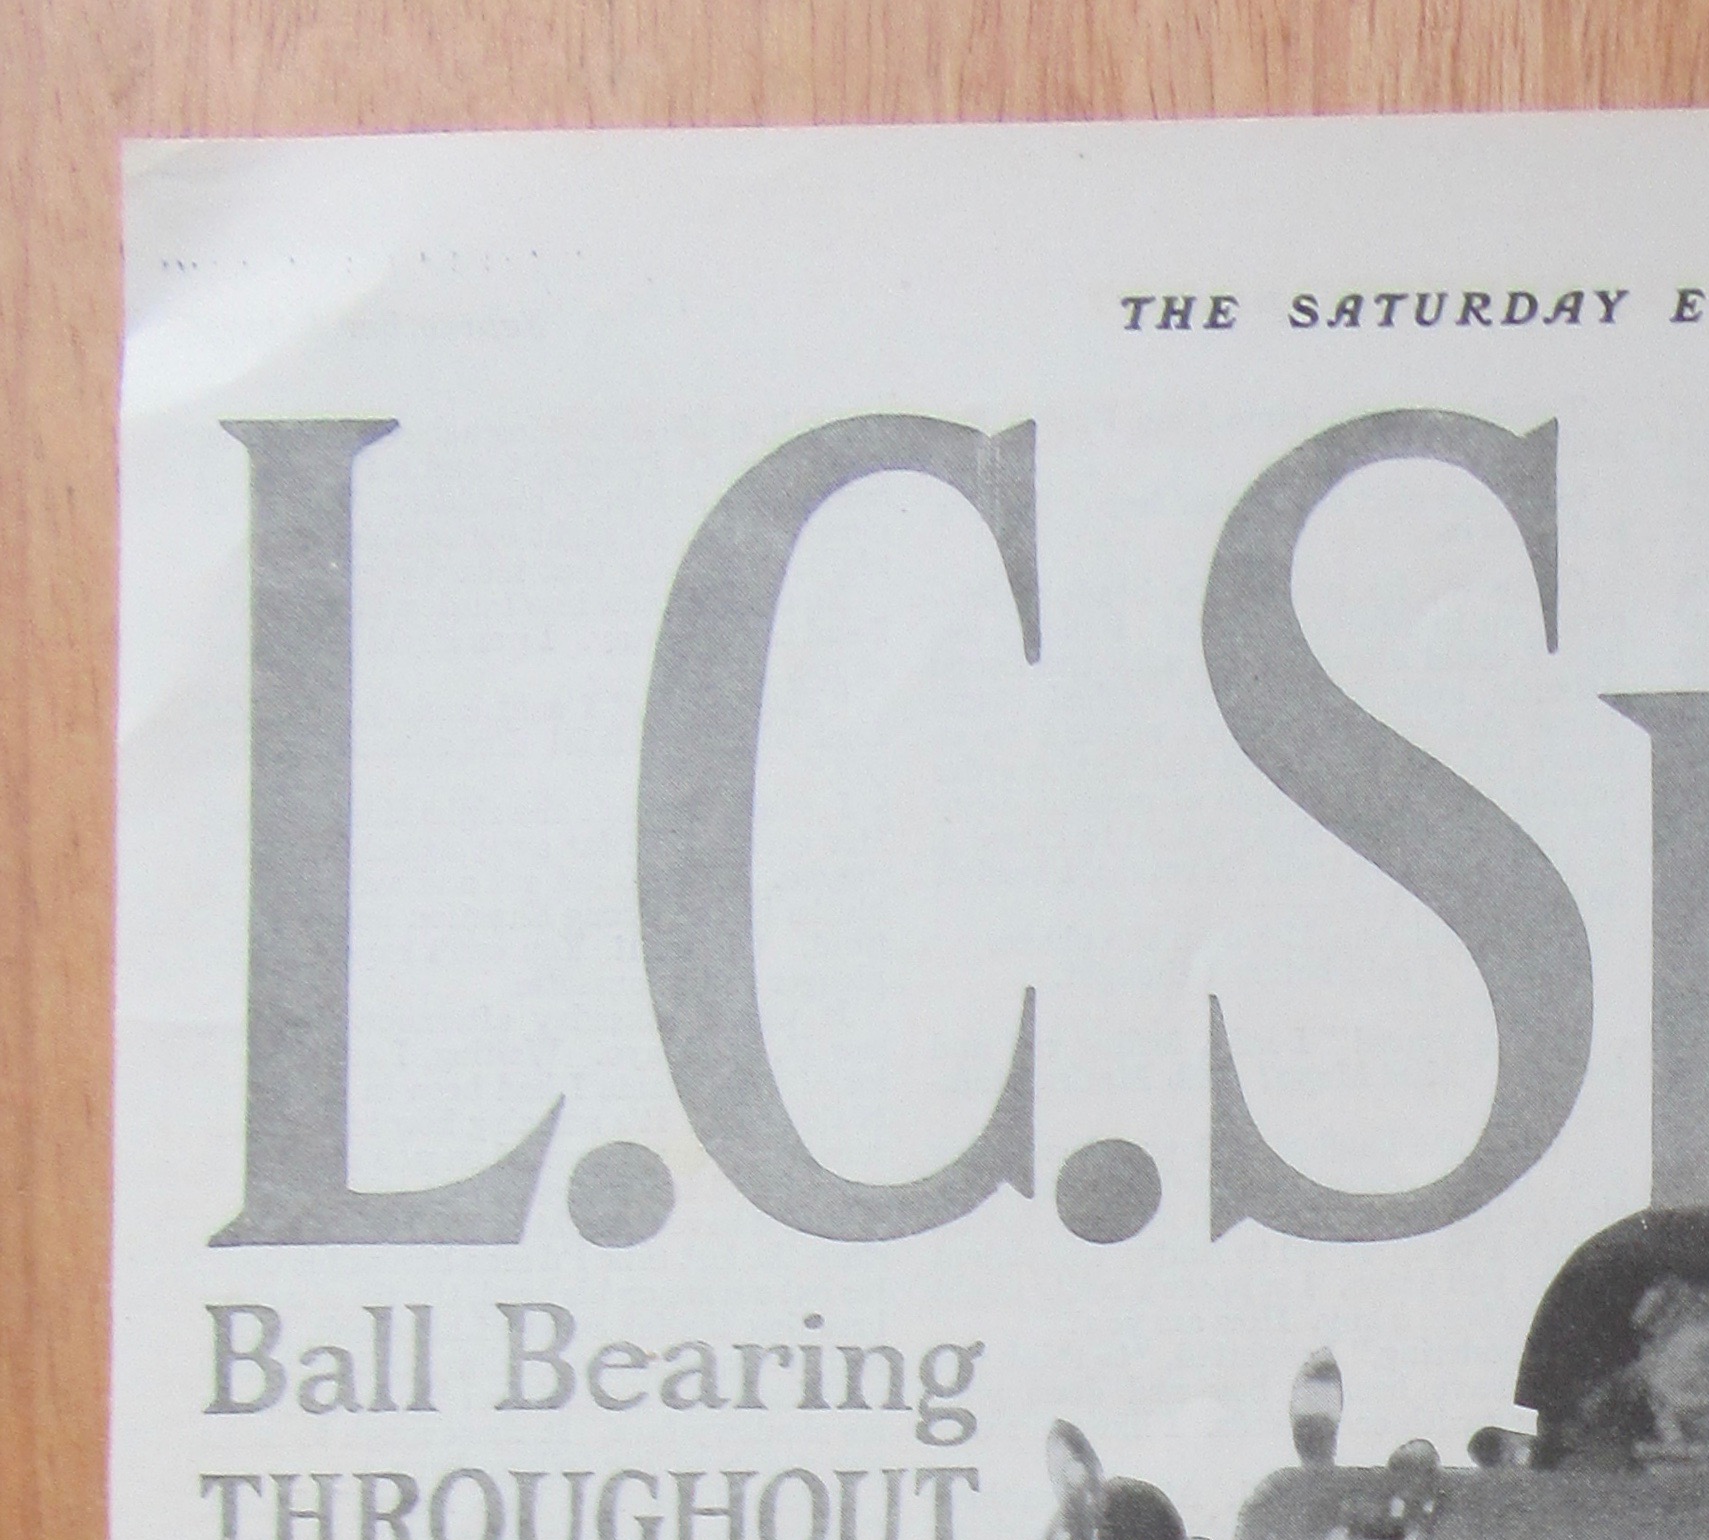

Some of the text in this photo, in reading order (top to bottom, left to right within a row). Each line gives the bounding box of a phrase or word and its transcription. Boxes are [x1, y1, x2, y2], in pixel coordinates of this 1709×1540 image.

[1121, 295, 1238, 331] THE
[1289, 289, 1629, 329] SATURDAY
[202, 1302, 986, 1447] Ball Bearing
